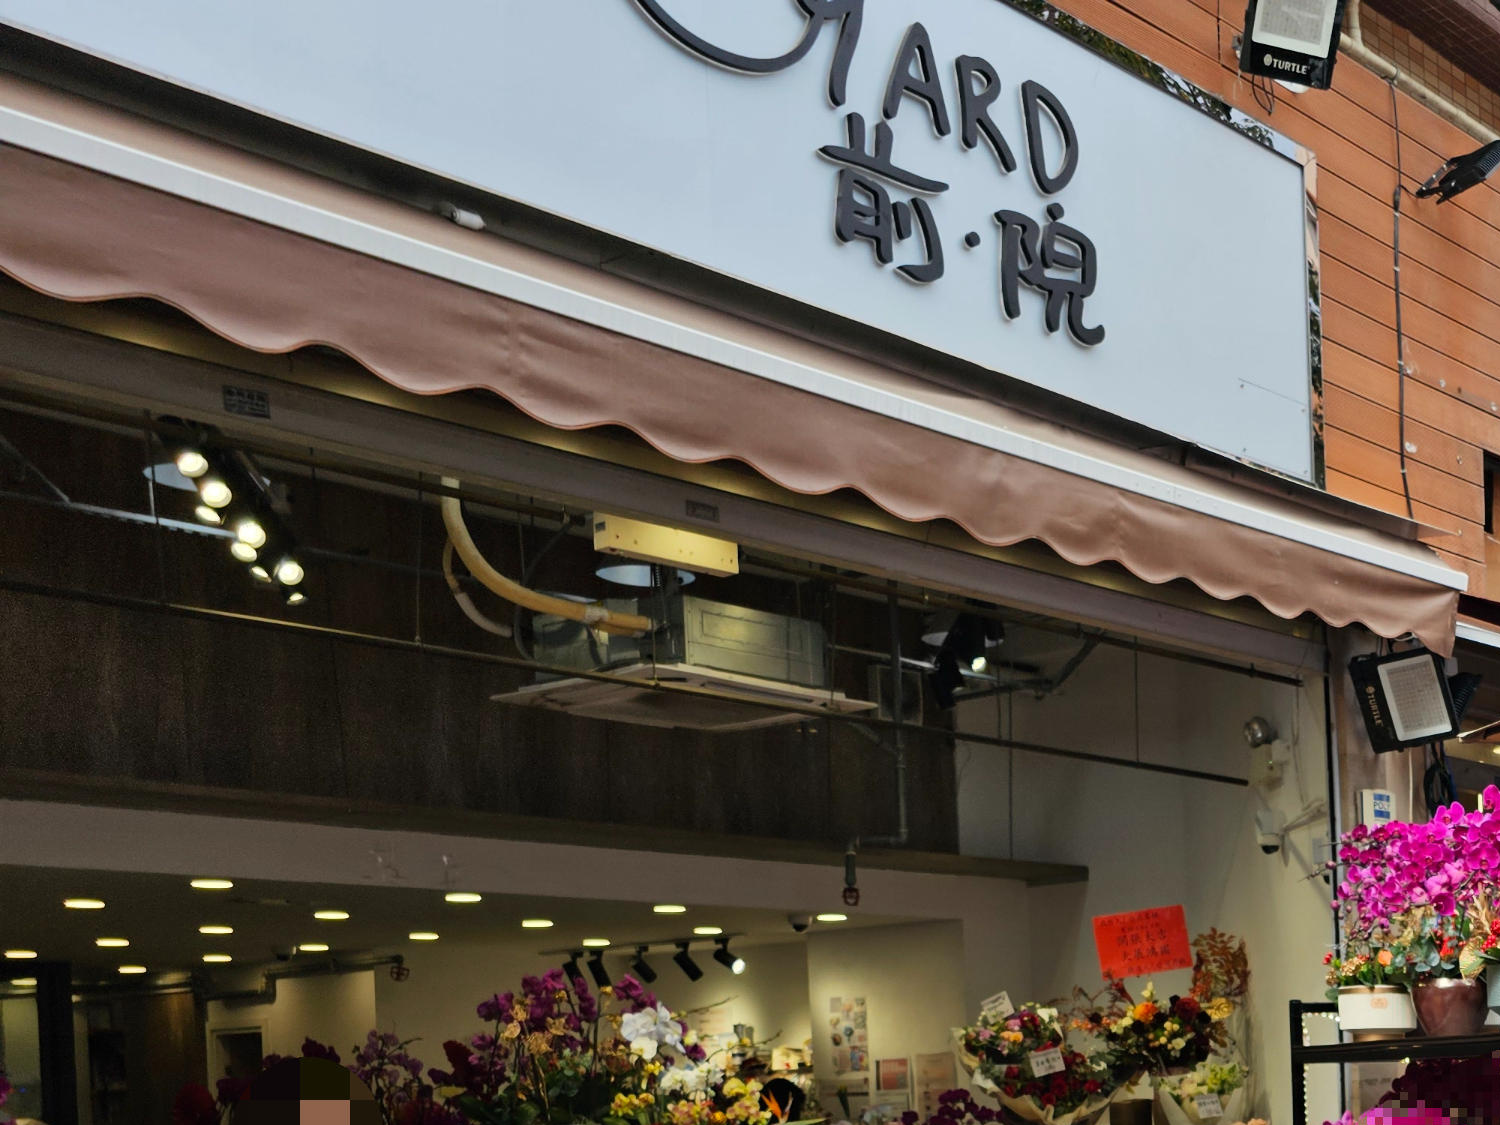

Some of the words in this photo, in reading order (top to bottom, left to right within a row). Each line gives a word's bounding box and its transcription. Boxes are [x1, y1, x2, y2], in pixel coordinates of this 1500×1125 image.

[1273, 58, 1308, 75] TURTLE
[1367, 695, 1382, 727] TURTLE
[1374, 801, 1390, 811] POLY
